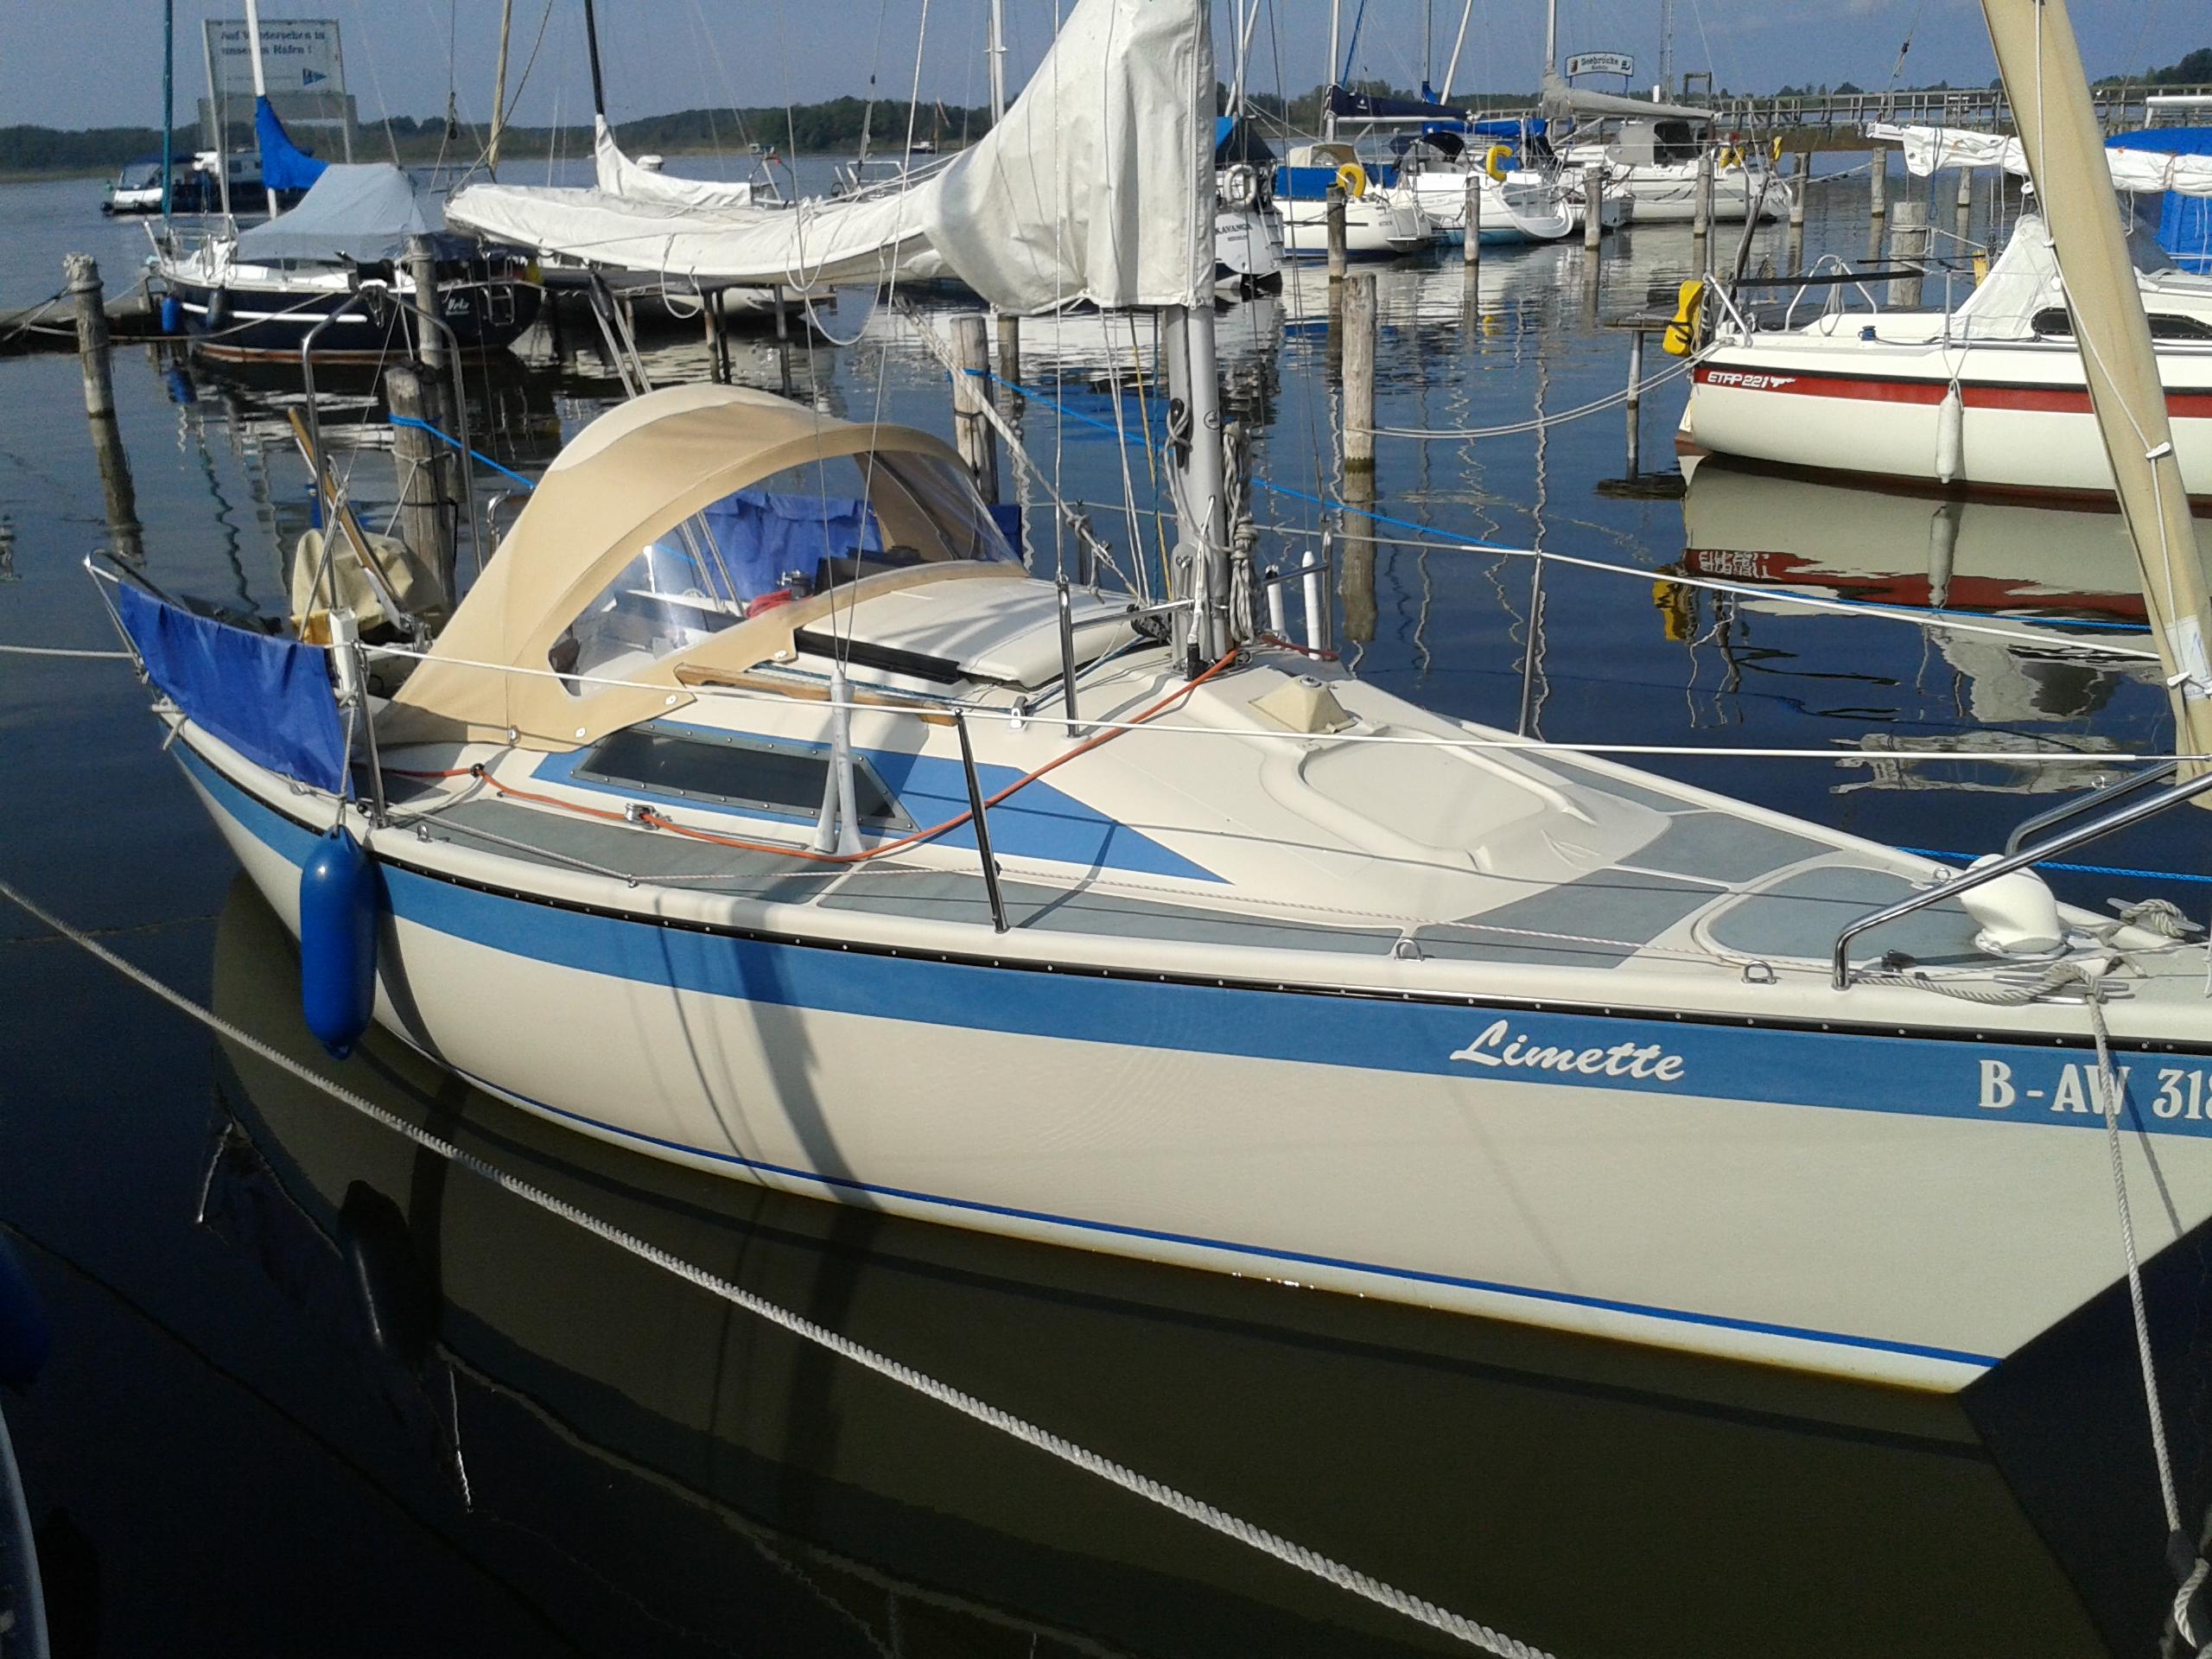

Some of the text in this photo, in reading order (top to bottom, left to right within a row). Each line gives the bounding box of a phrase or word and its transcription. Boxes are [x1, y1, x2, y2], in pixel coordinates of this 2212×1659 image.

[273, 44, 304, 54] Hafen
[1707, 371, 1743, 385] ETAP
[1449, 1019, 1685, 1081] Limette
[2152, 1068, 2212, 1121] 31
